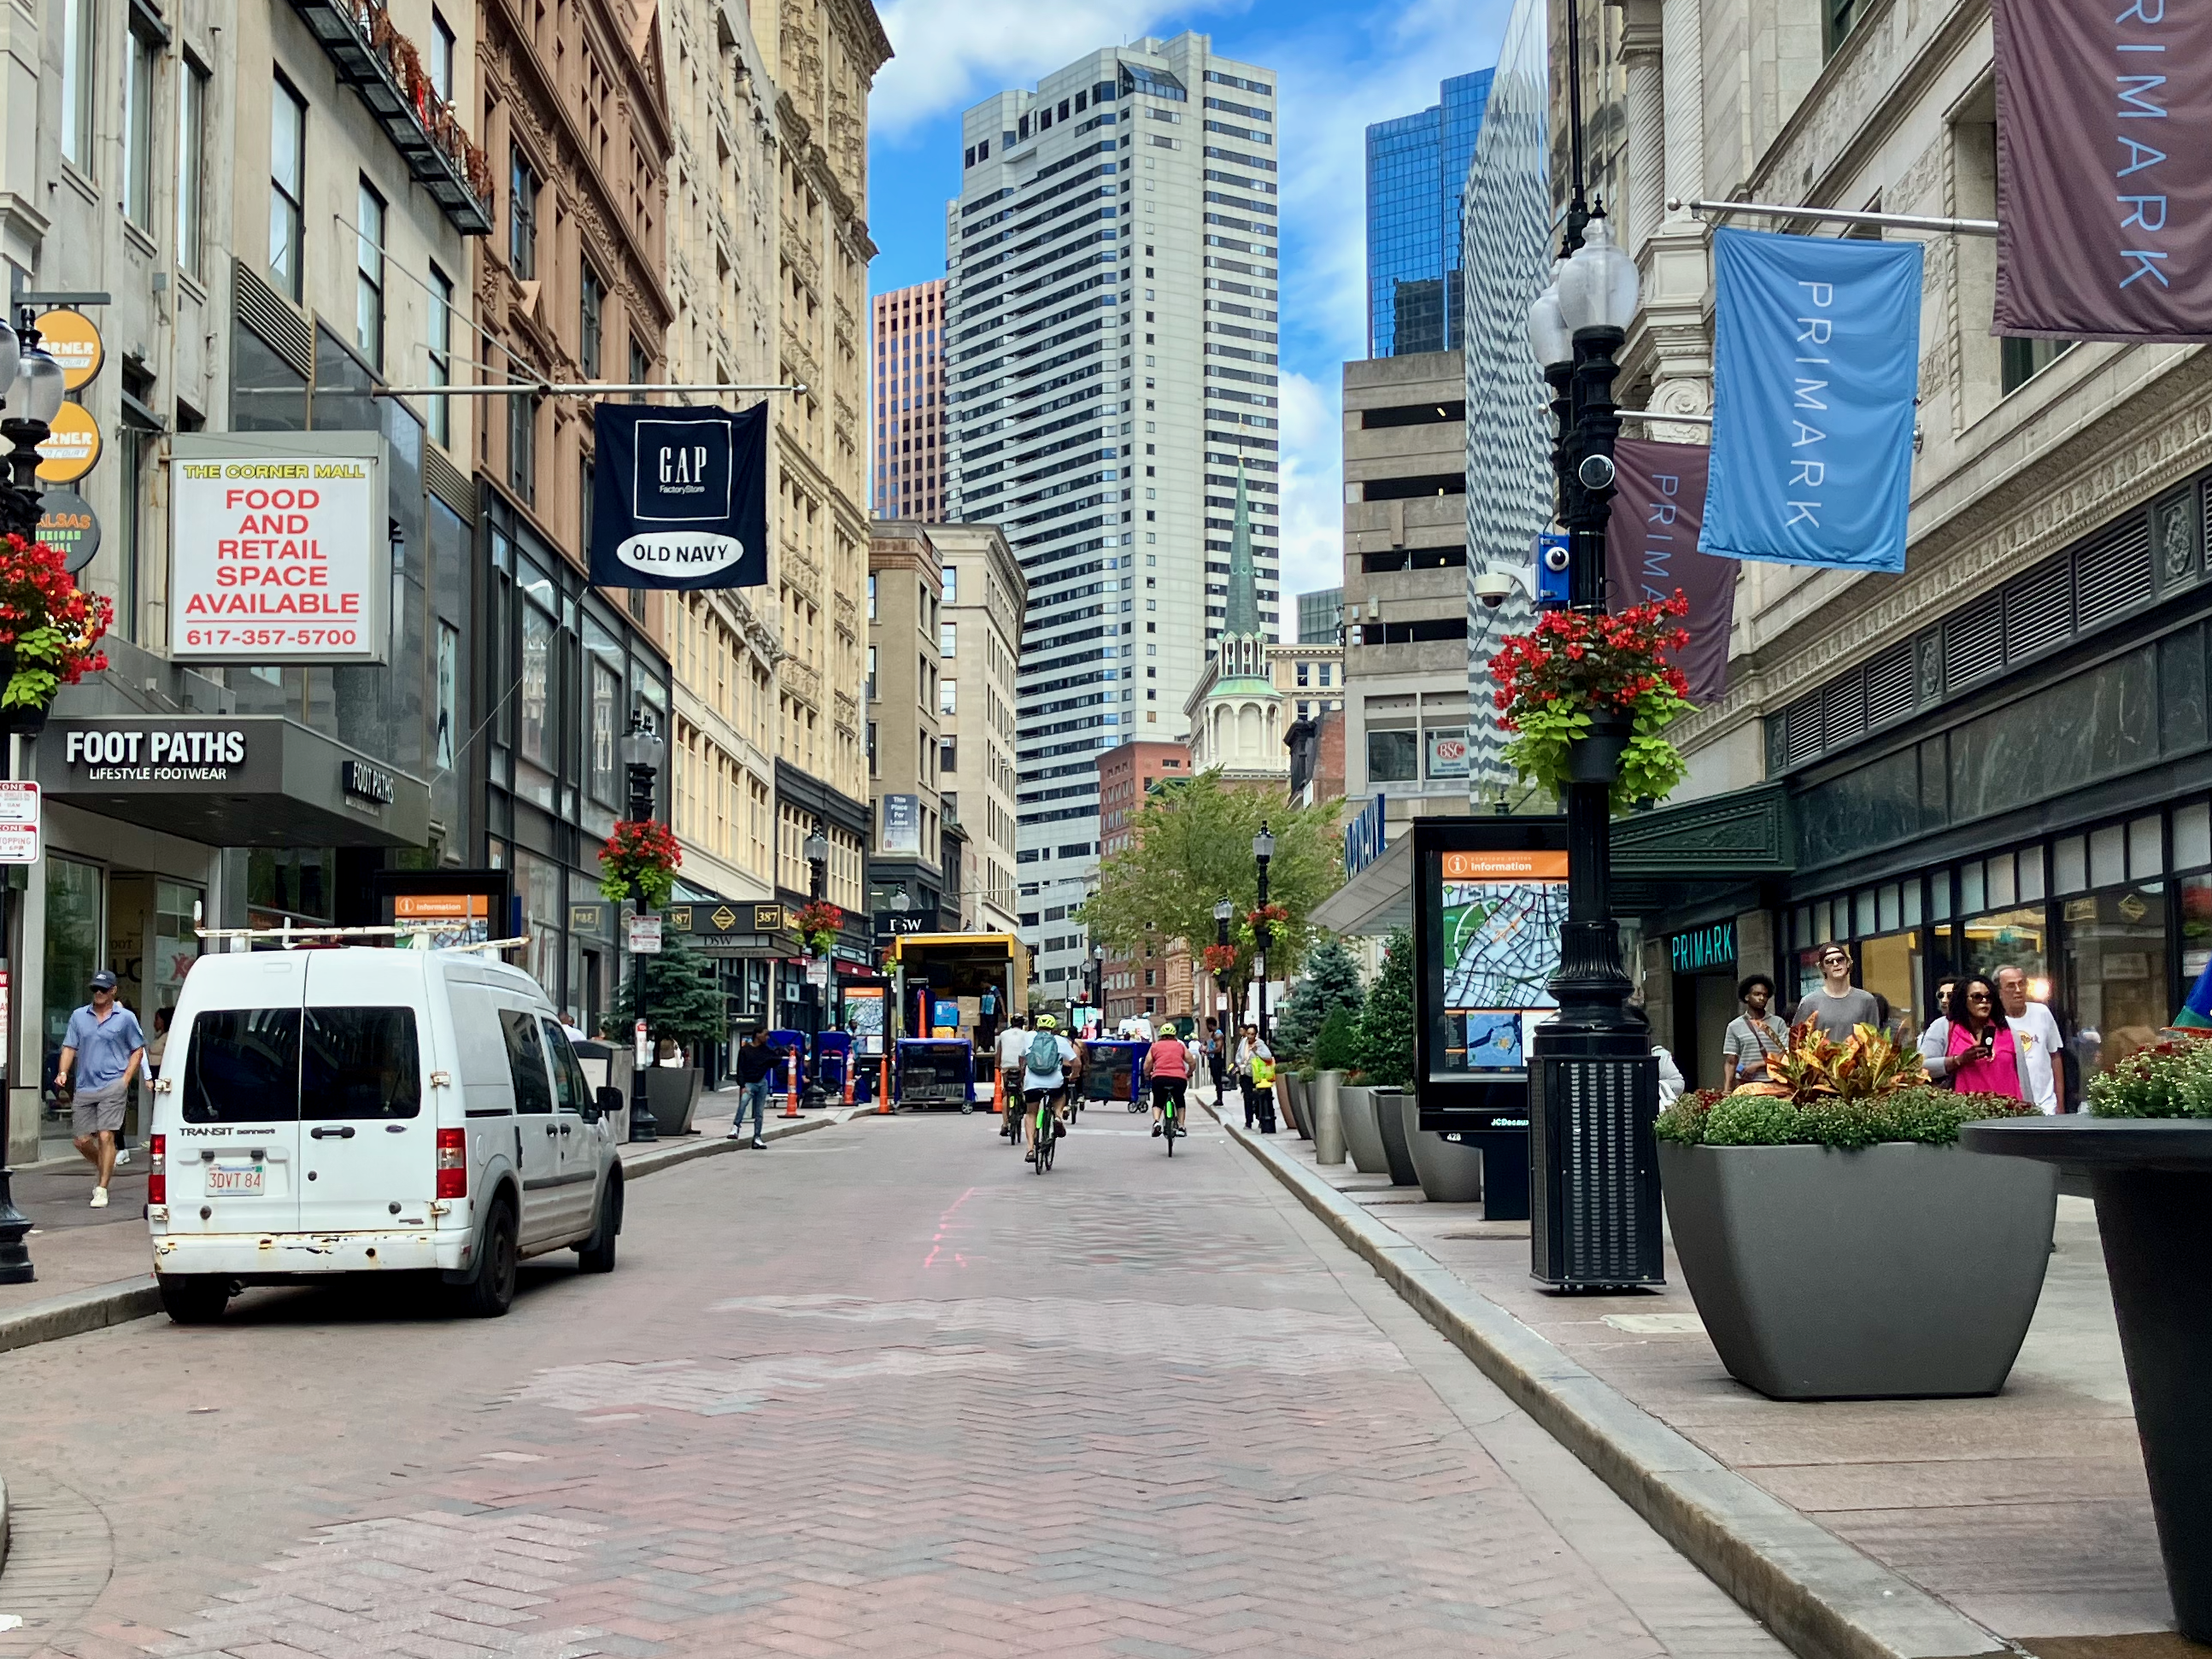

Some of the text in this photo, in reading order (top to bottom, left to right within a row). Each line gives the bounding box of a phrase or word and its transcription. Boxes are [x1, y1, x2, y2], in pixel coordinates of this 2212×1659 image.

[2115, 0, 2168, 288] RIMARK
[37, 342, 94, 355] ORNER
[1786, 281, 1834, 529] PRIMARK
[184, 465, 366, 478] THE CORNER MALL
[660, 447, 707, 484] GAP
[226, 489, 320, 509] FOOD
[238, 514, 309, 534] AND
[1640, 474, 1679, 603] PRIMA
[218, 539, 327, 560] RETAIL
[633, 544, 728, 562] OLD NAVY
[216, 566, 328, 587] SPACE
[185, 593, 360, 614] AVAILABLE
[186, 630, 356, 646] 617-357-5700
[67, 731, 244, 764] FOOT PATHS
[90, 768, 227, 780] LIFESTYLE FOOTWEAR
[352, 761, 395, 804] FOOT PATHS
[1470, 862, 1532, 871] Information
[757, 912, 777, 923] 387
[704, 935, 733, 947] DSW
[1672, 923, 1734, 972] PRIMARK
[179, 1127, 234, 1136] TRANSIT
[208, 1172, 261, 1188] 3DVT 84
